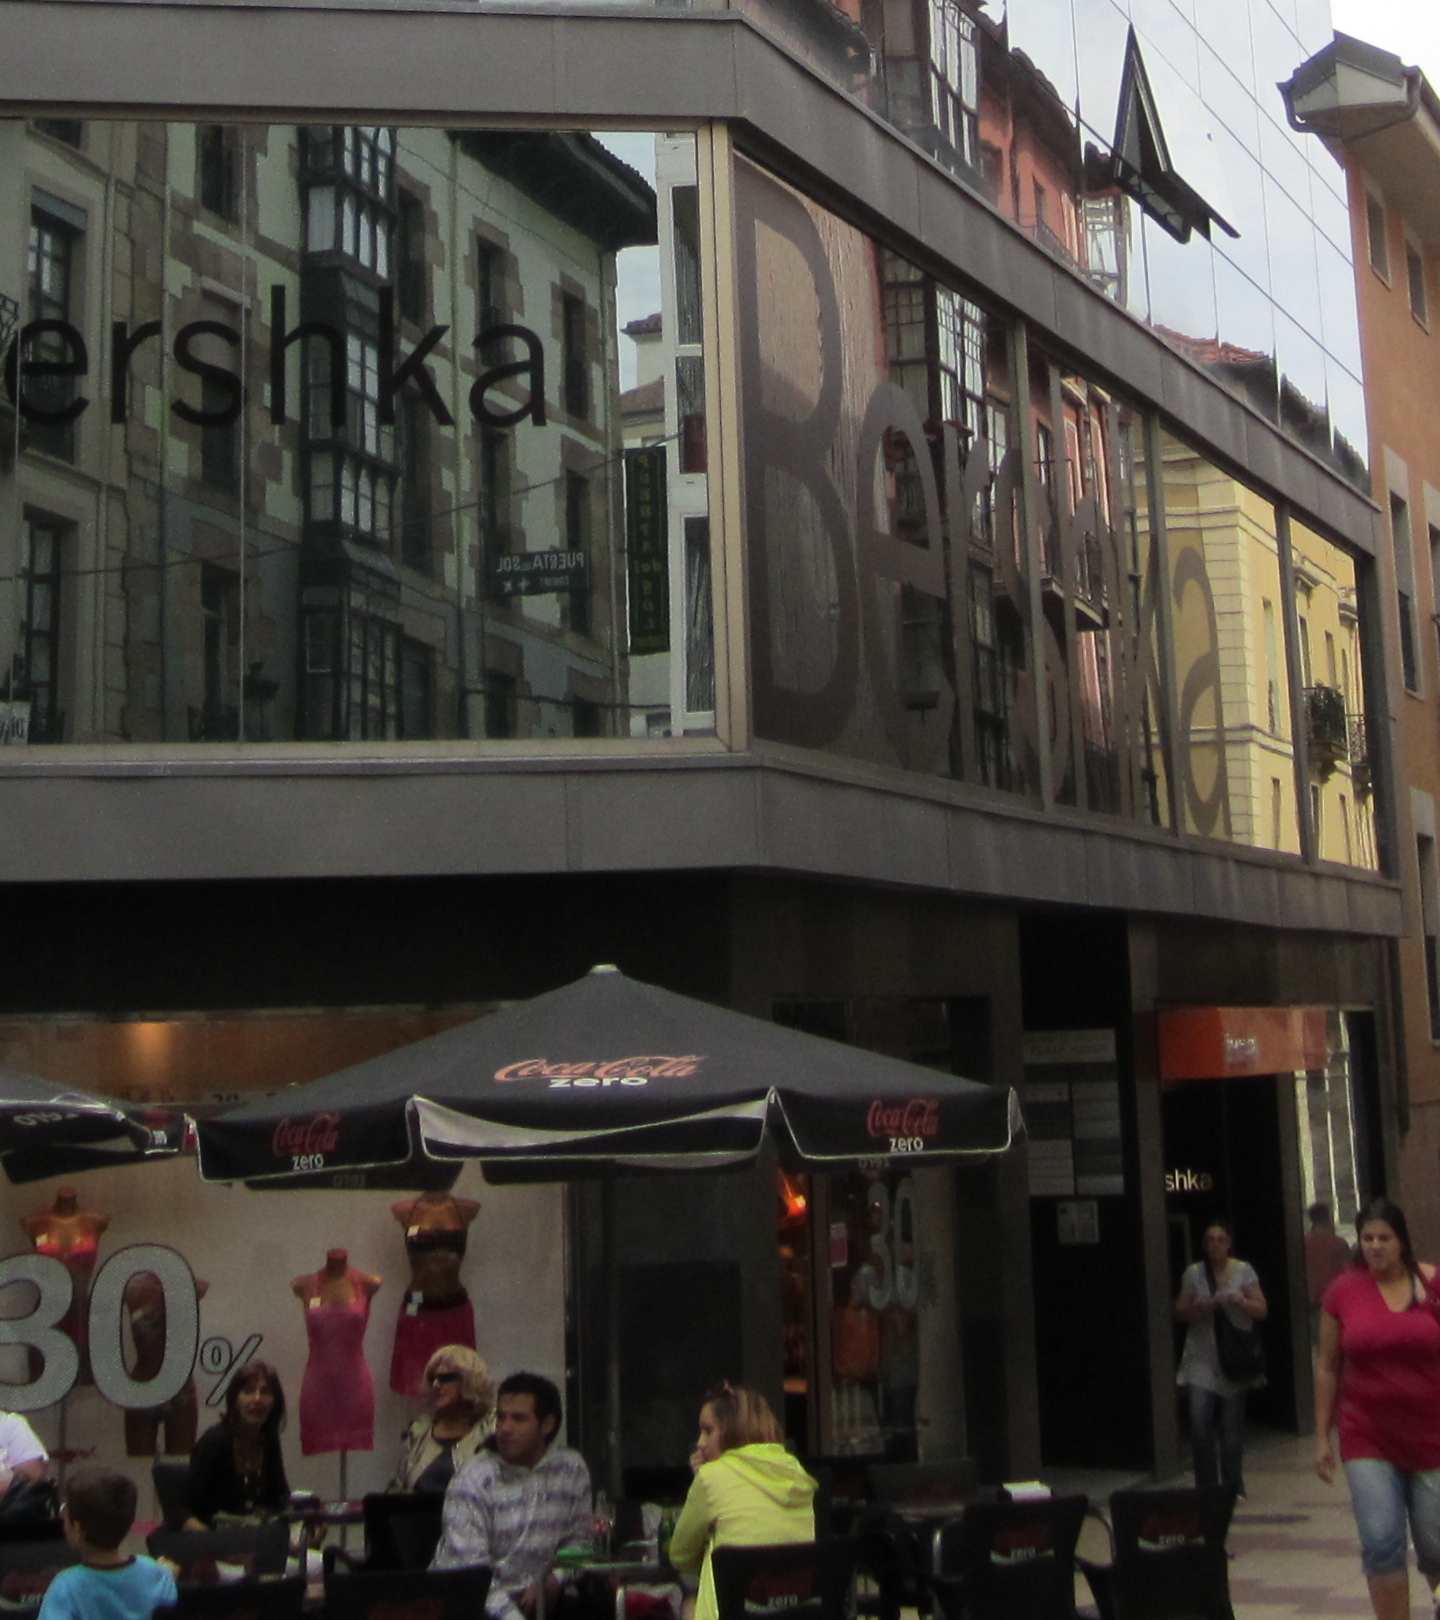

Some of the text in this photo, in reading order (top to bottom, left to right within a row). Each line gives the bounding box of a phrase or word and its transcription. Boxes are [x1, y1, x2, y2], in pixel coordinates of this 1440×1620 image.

[548, 1076, 649, 1089] zero
[888, 1137, 925, 1153] zero
[292, 1153, 325, 1171] zero
[1157, 1534, 1186, 1547] zero
[1010, 1546, 1037, 1560] zero
[768, 1593, 799, 1608] zero
